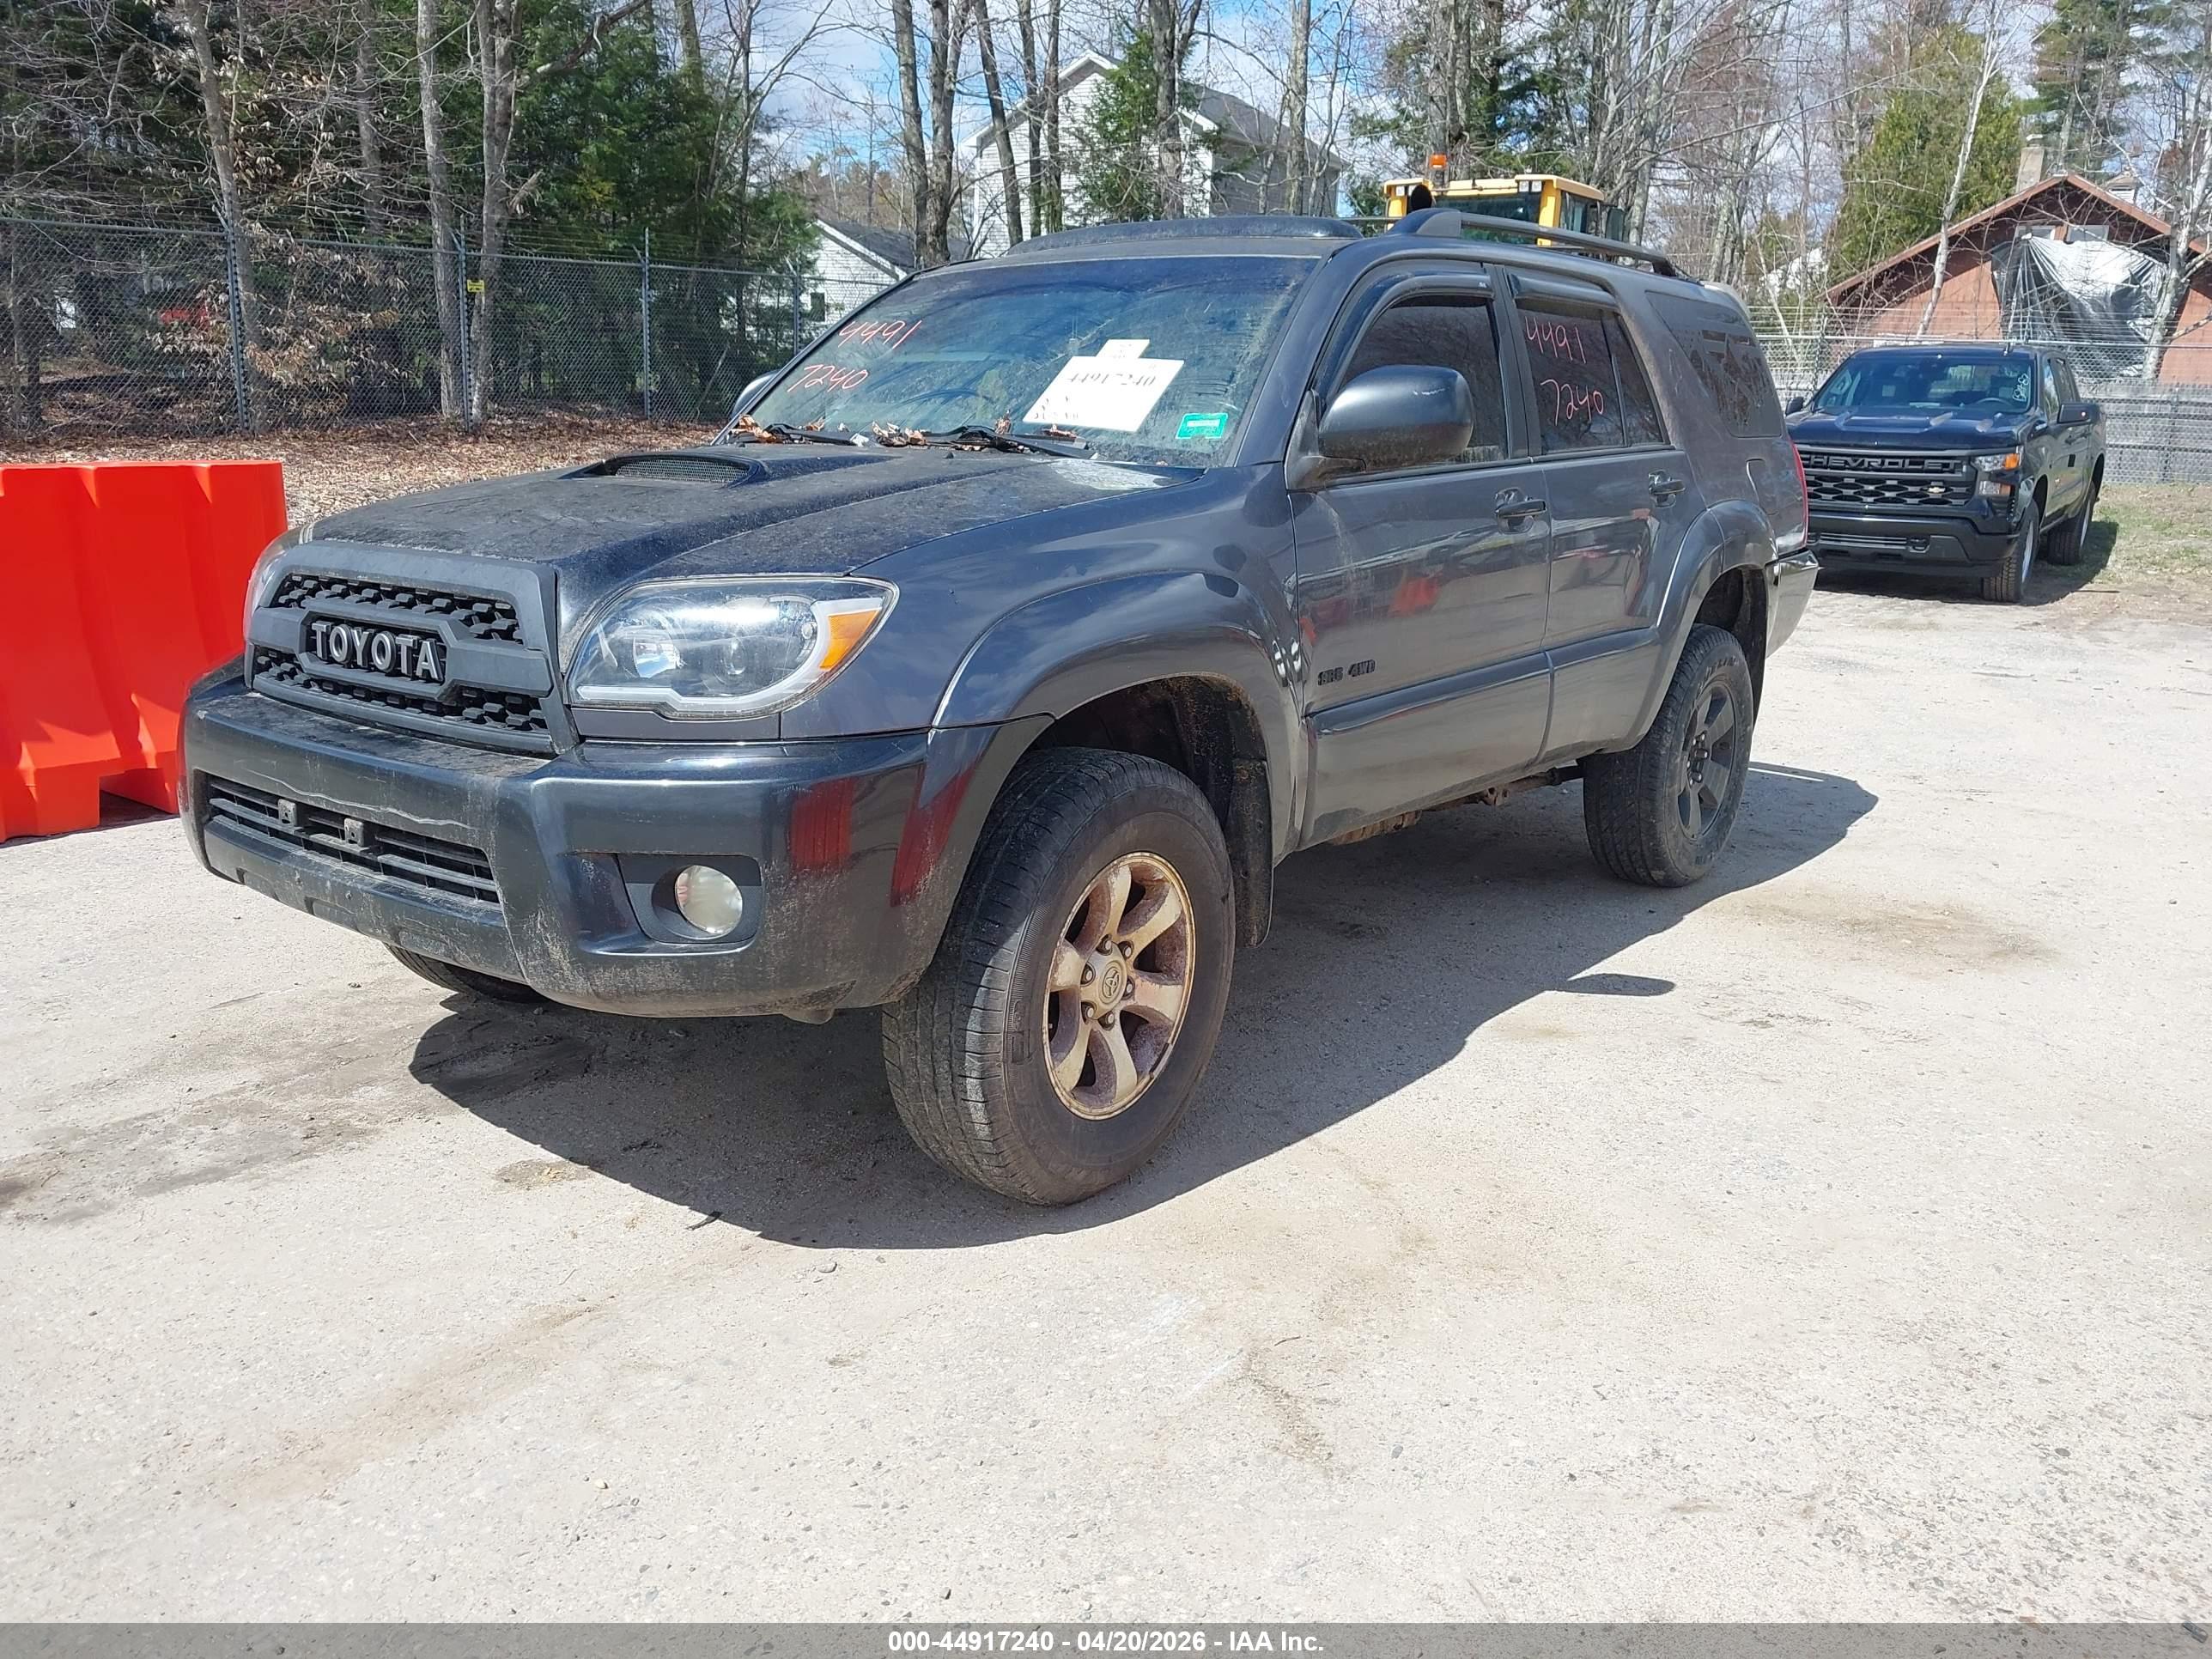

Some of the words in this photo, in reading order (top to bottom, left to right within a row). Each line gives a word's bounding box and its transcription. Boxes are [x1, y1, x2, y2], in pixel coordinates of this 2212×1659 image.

[837, 319, 923, 349] 4491
[1524, 315, 1587, 364] 4491
[787, 363, 869, 392] 7240
[1540, 378, 1604, 427] 7240
[311, 620, 445, 683] TOYOTA
[1347, 659, 1376, 678] 4WD
